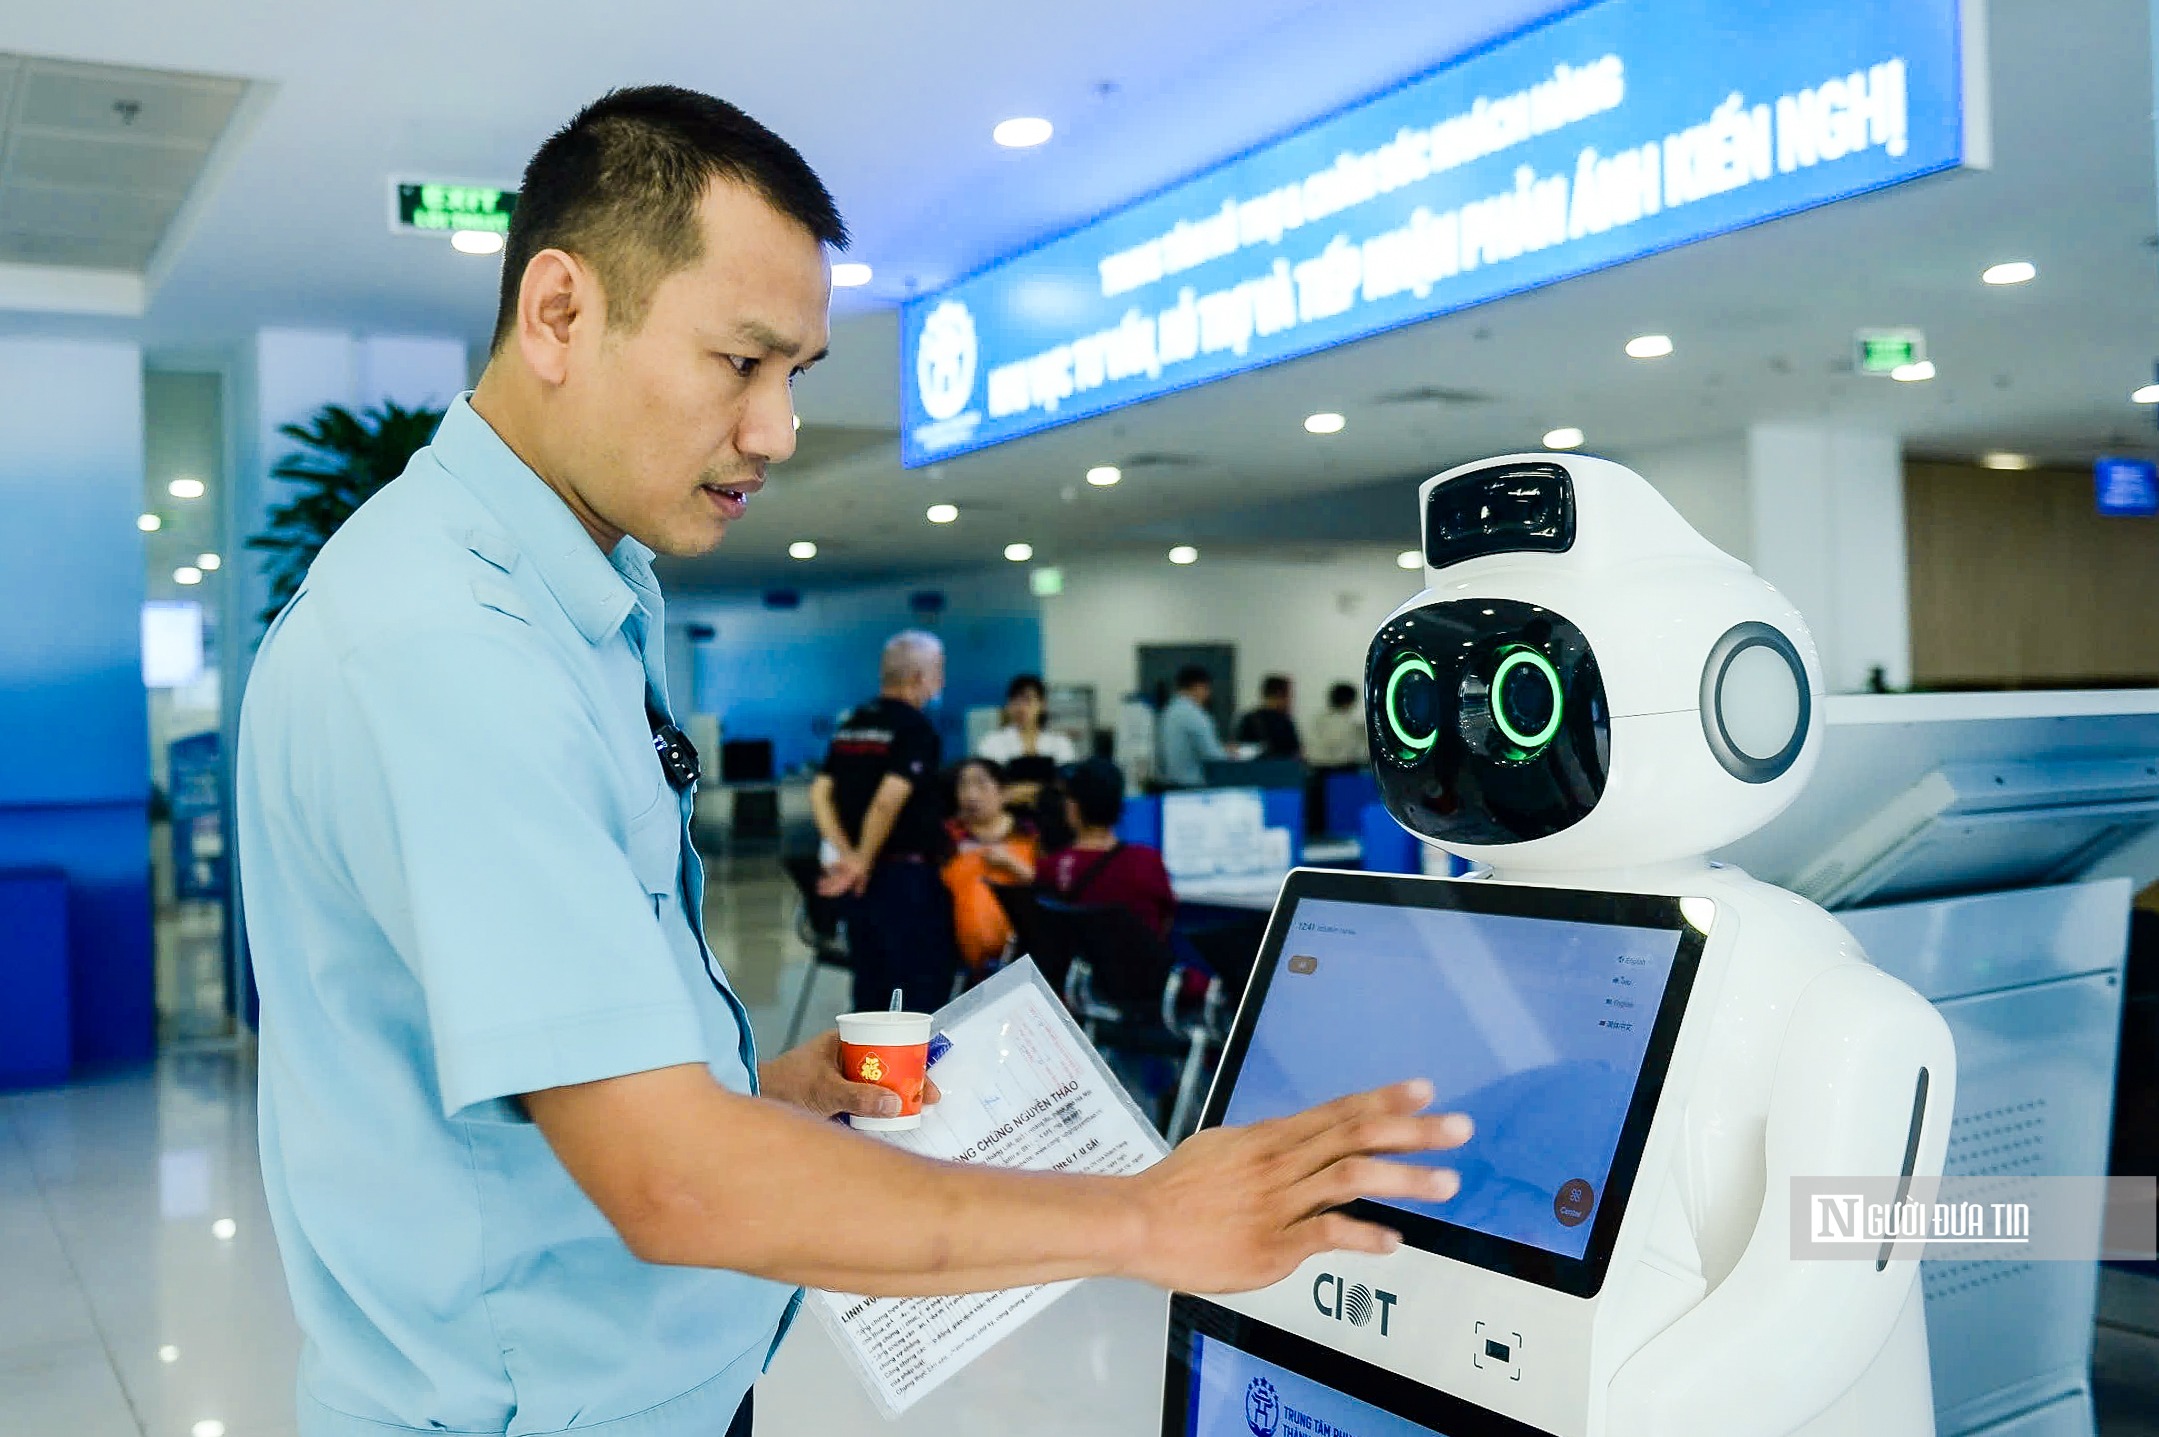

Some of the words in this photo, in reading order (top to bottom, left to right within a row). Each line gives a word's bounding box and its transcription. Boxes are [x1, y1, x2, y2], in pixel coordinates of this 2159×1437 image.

[1568, 144, 1660, 238] ÁNH
[1664, 95, 1771, 206] KIẾN
[1777, 60, 1905, 171] NGHỊ
[977, 1123, 1014, 1151] CHỨNG
[1012, 1098, 1052, 1128] NGUYỄN
[1050, 1080, 1079, 1102] THẢO
[1284, 1406, 1312, 1430] TRUNG
[1313, 1419, 1331, 1436] TÂM
